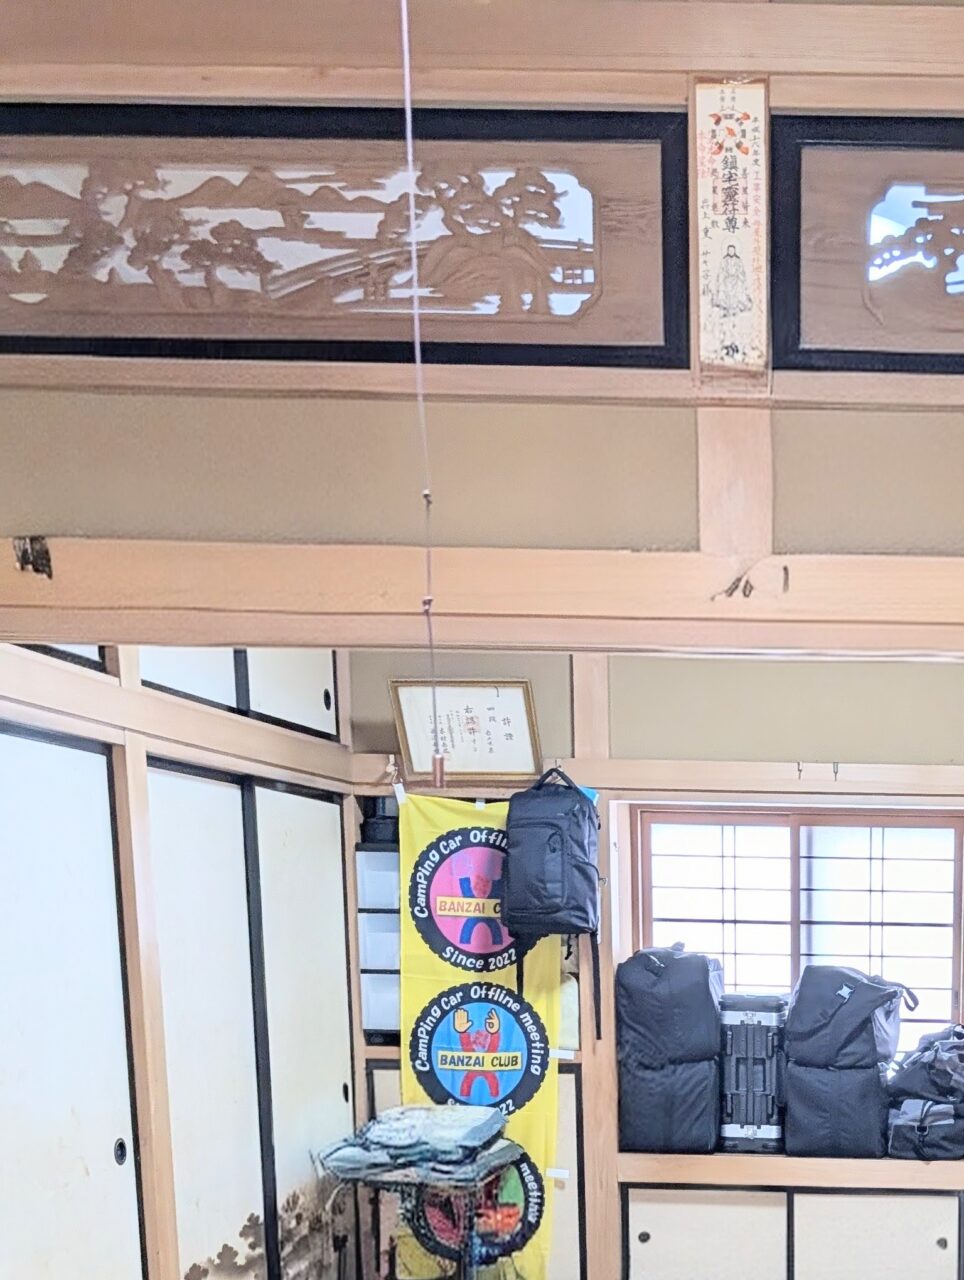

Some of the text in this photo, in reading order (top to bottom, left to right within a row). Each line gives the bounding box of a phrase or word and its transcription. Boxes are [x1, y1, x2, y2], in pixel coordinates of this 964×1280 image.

[439, 835, 463, 855] Car
[438, 900, 486, 914] BANZAI
[442, 946, 517, 970] Since 2022
[440, 991, 464, 1011] Car
[470, 985, 521, 1012] Offline
[519, 1011, 545, 1076] meeting
[439, 1054, 519, 1068] BANZAI CLUB
